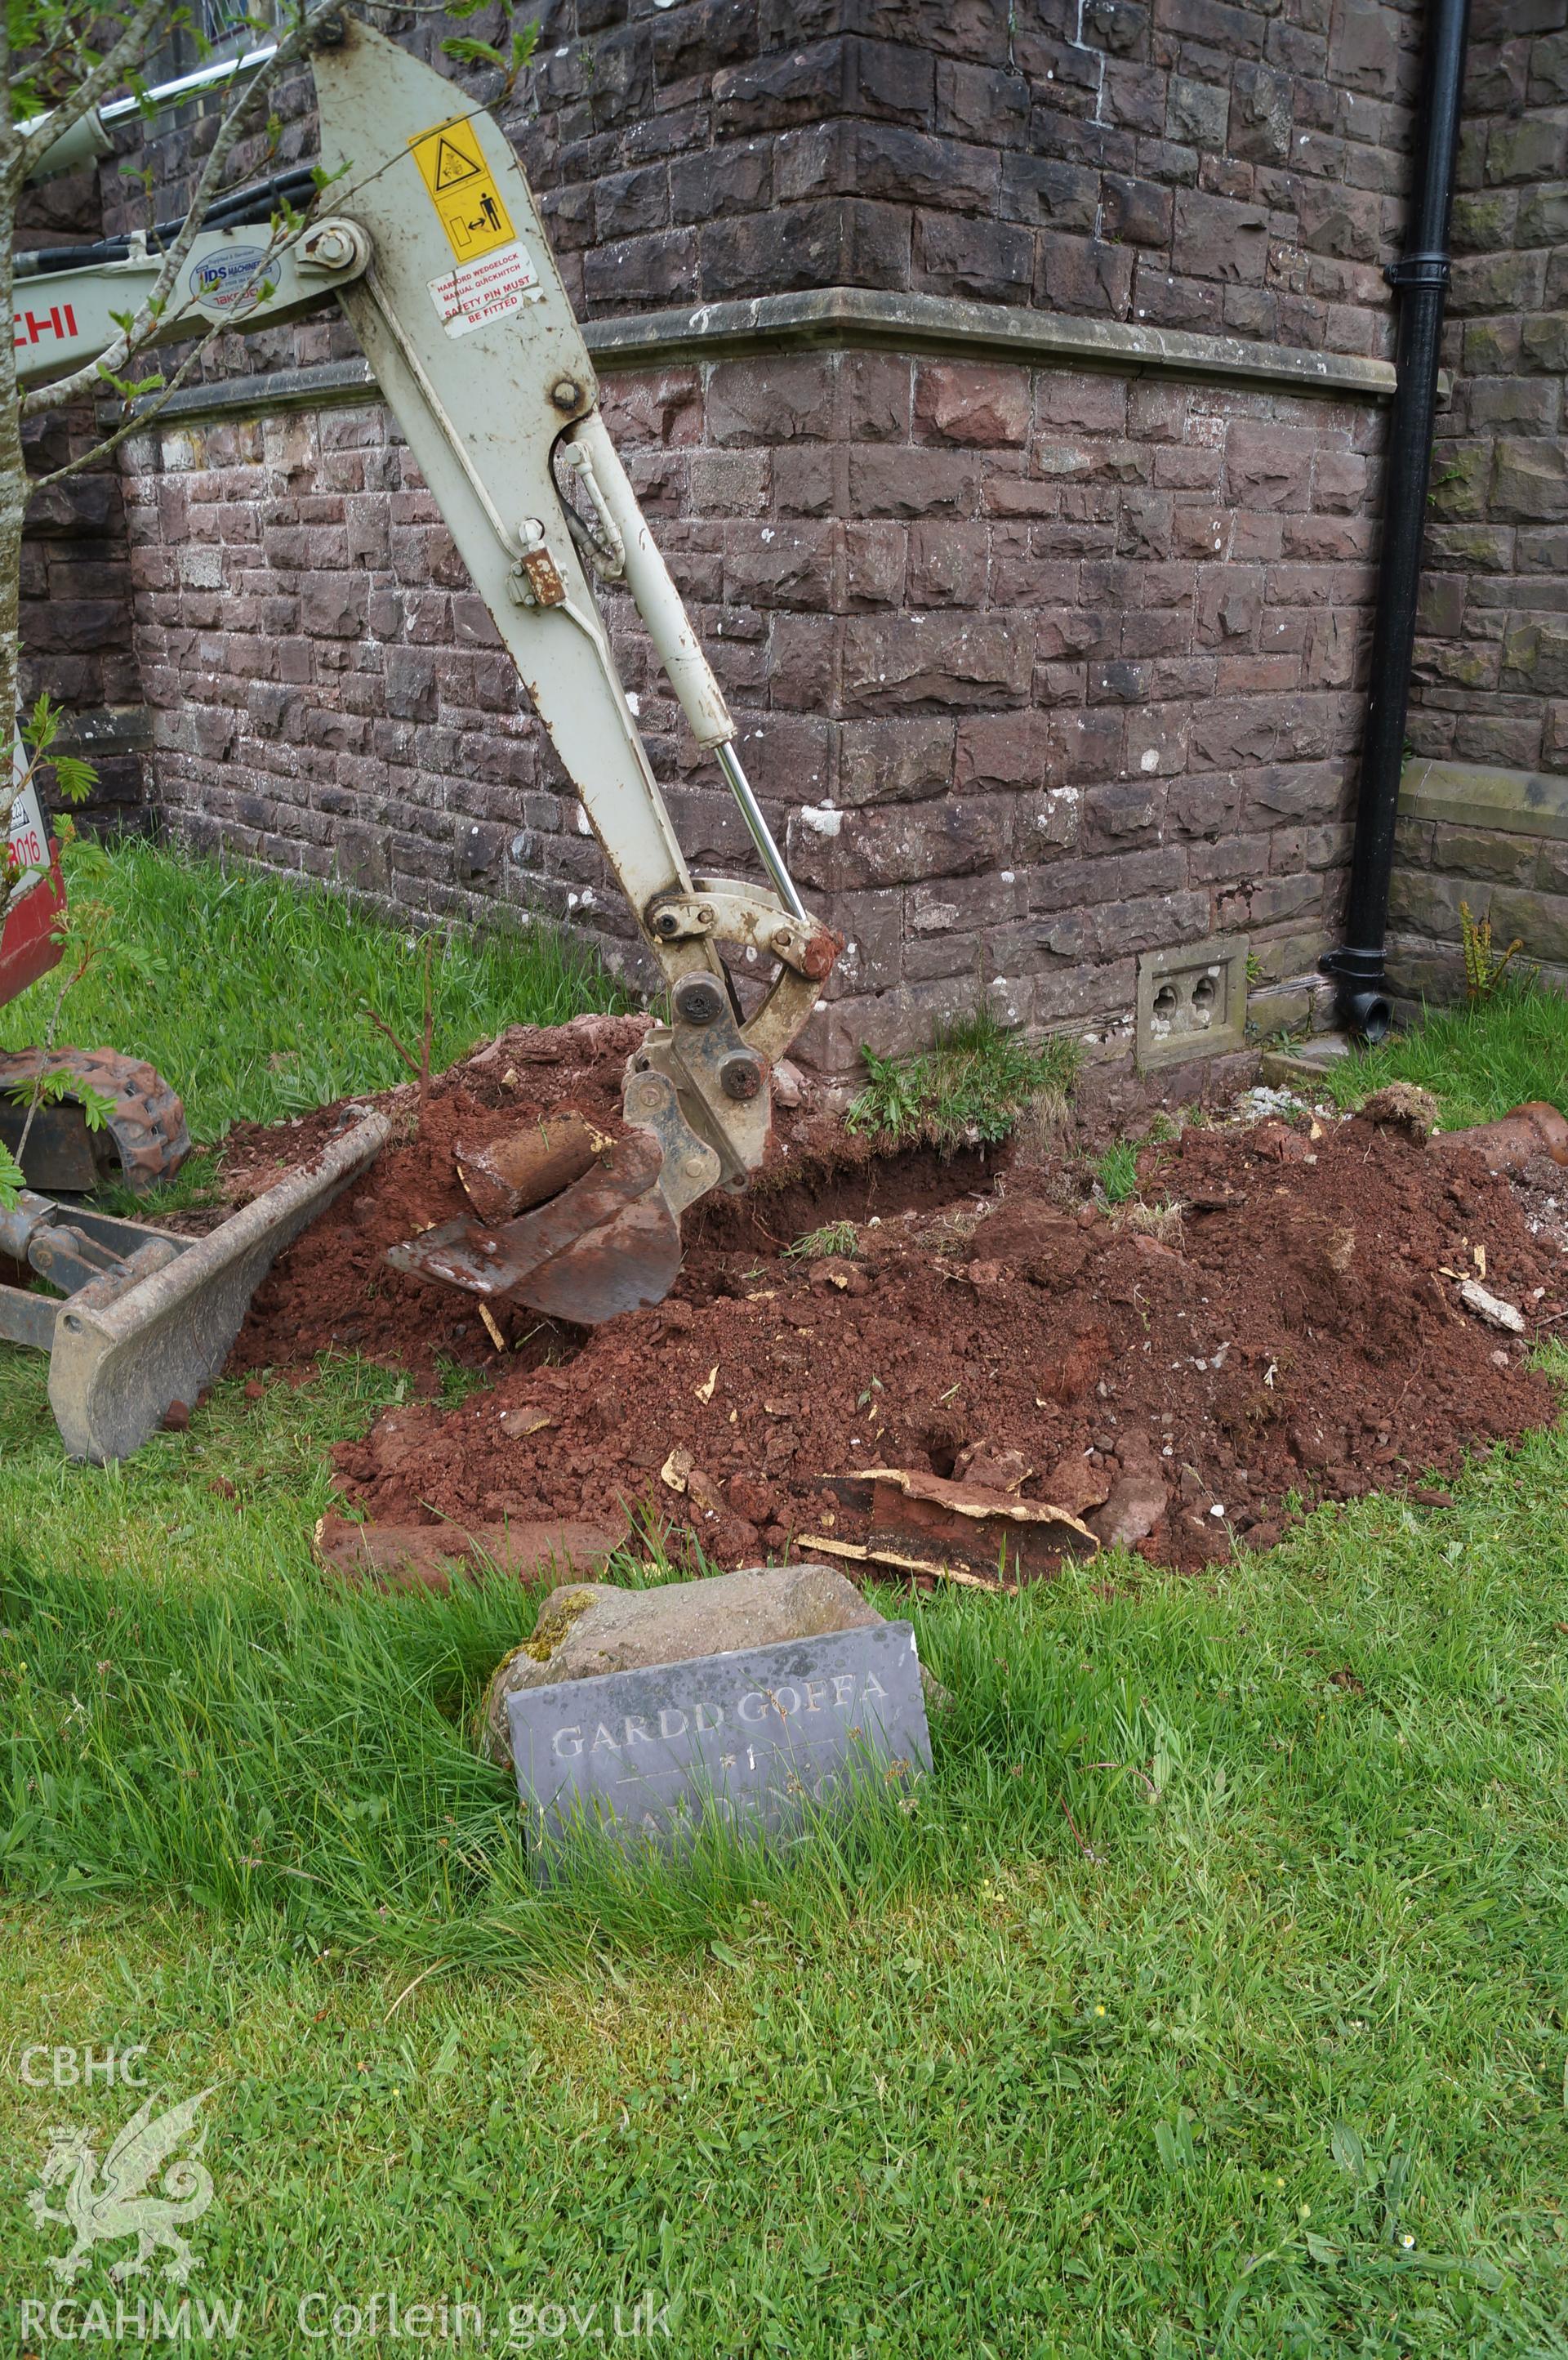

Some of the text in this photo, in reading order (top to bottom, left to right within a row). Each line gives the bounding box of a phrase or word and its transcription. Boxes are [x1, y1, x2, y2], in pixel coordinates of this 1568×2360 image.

[228, 260, 263, 275] MACHINE
[437, 252, 519, 292] HARFORD WEDGELOCK
[443, 264, 521, 301] MANUAL QUICKHITCH
[444, 274, 531, 319] SAFETY PIN MUST
[468, 297, 518, 323] BE FITTED
[551, 1670, 889, 1759] GARDD GOFFA
